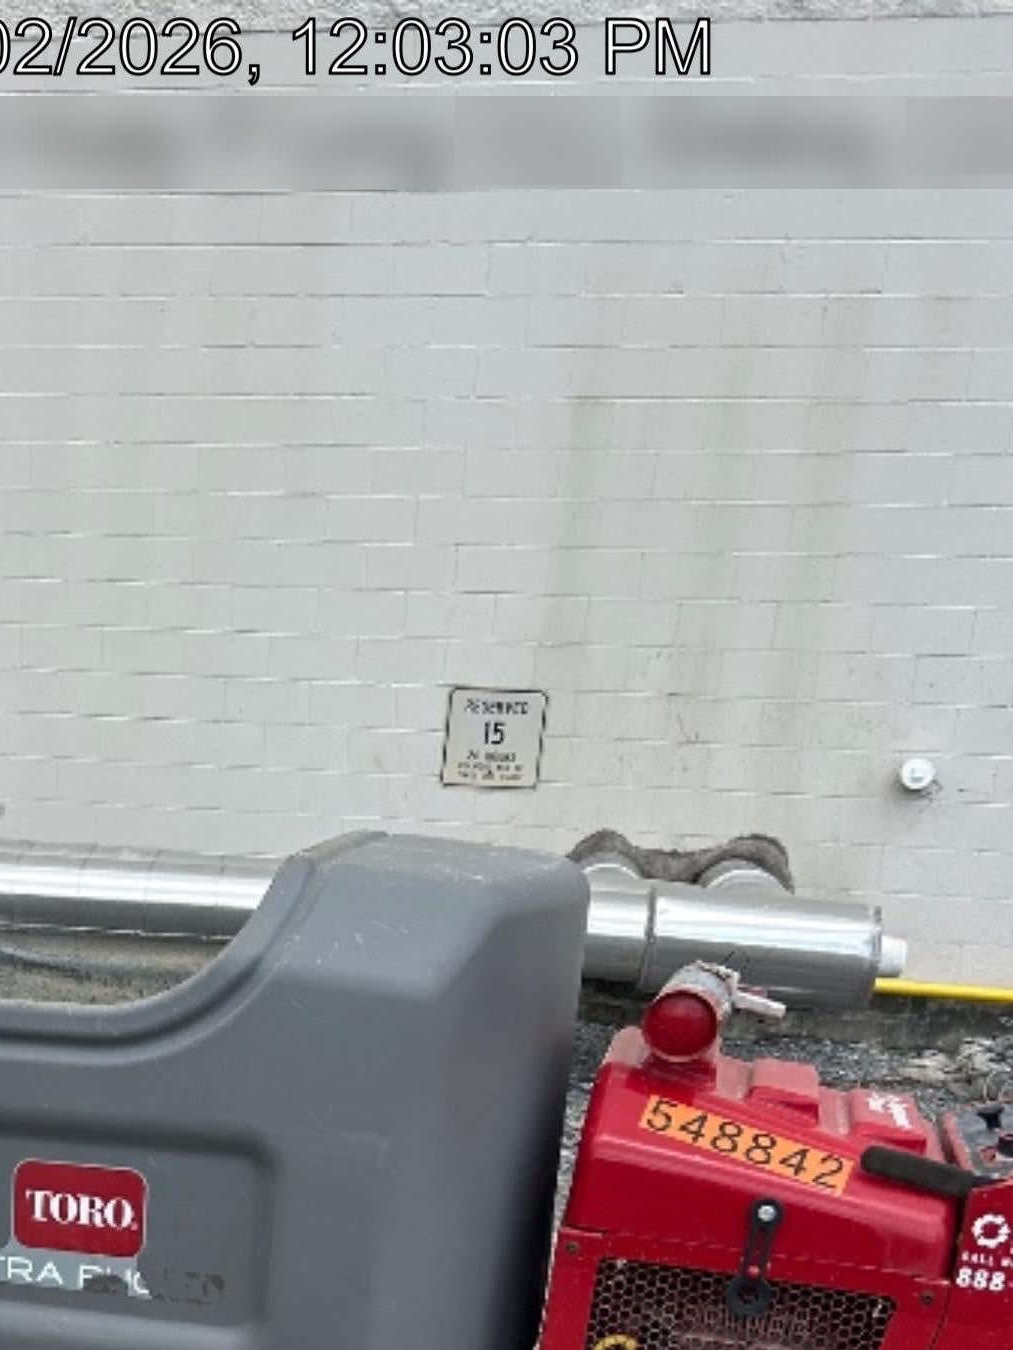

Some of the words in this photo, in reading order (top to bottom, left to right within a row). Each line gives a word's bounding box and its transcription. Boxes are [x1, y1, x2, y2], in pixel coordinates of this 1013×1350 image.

[484, 722, 506, 745] 15
[645, 1097, 845, 1190] 548842
[25, 1189, 135, 1231] TORO
